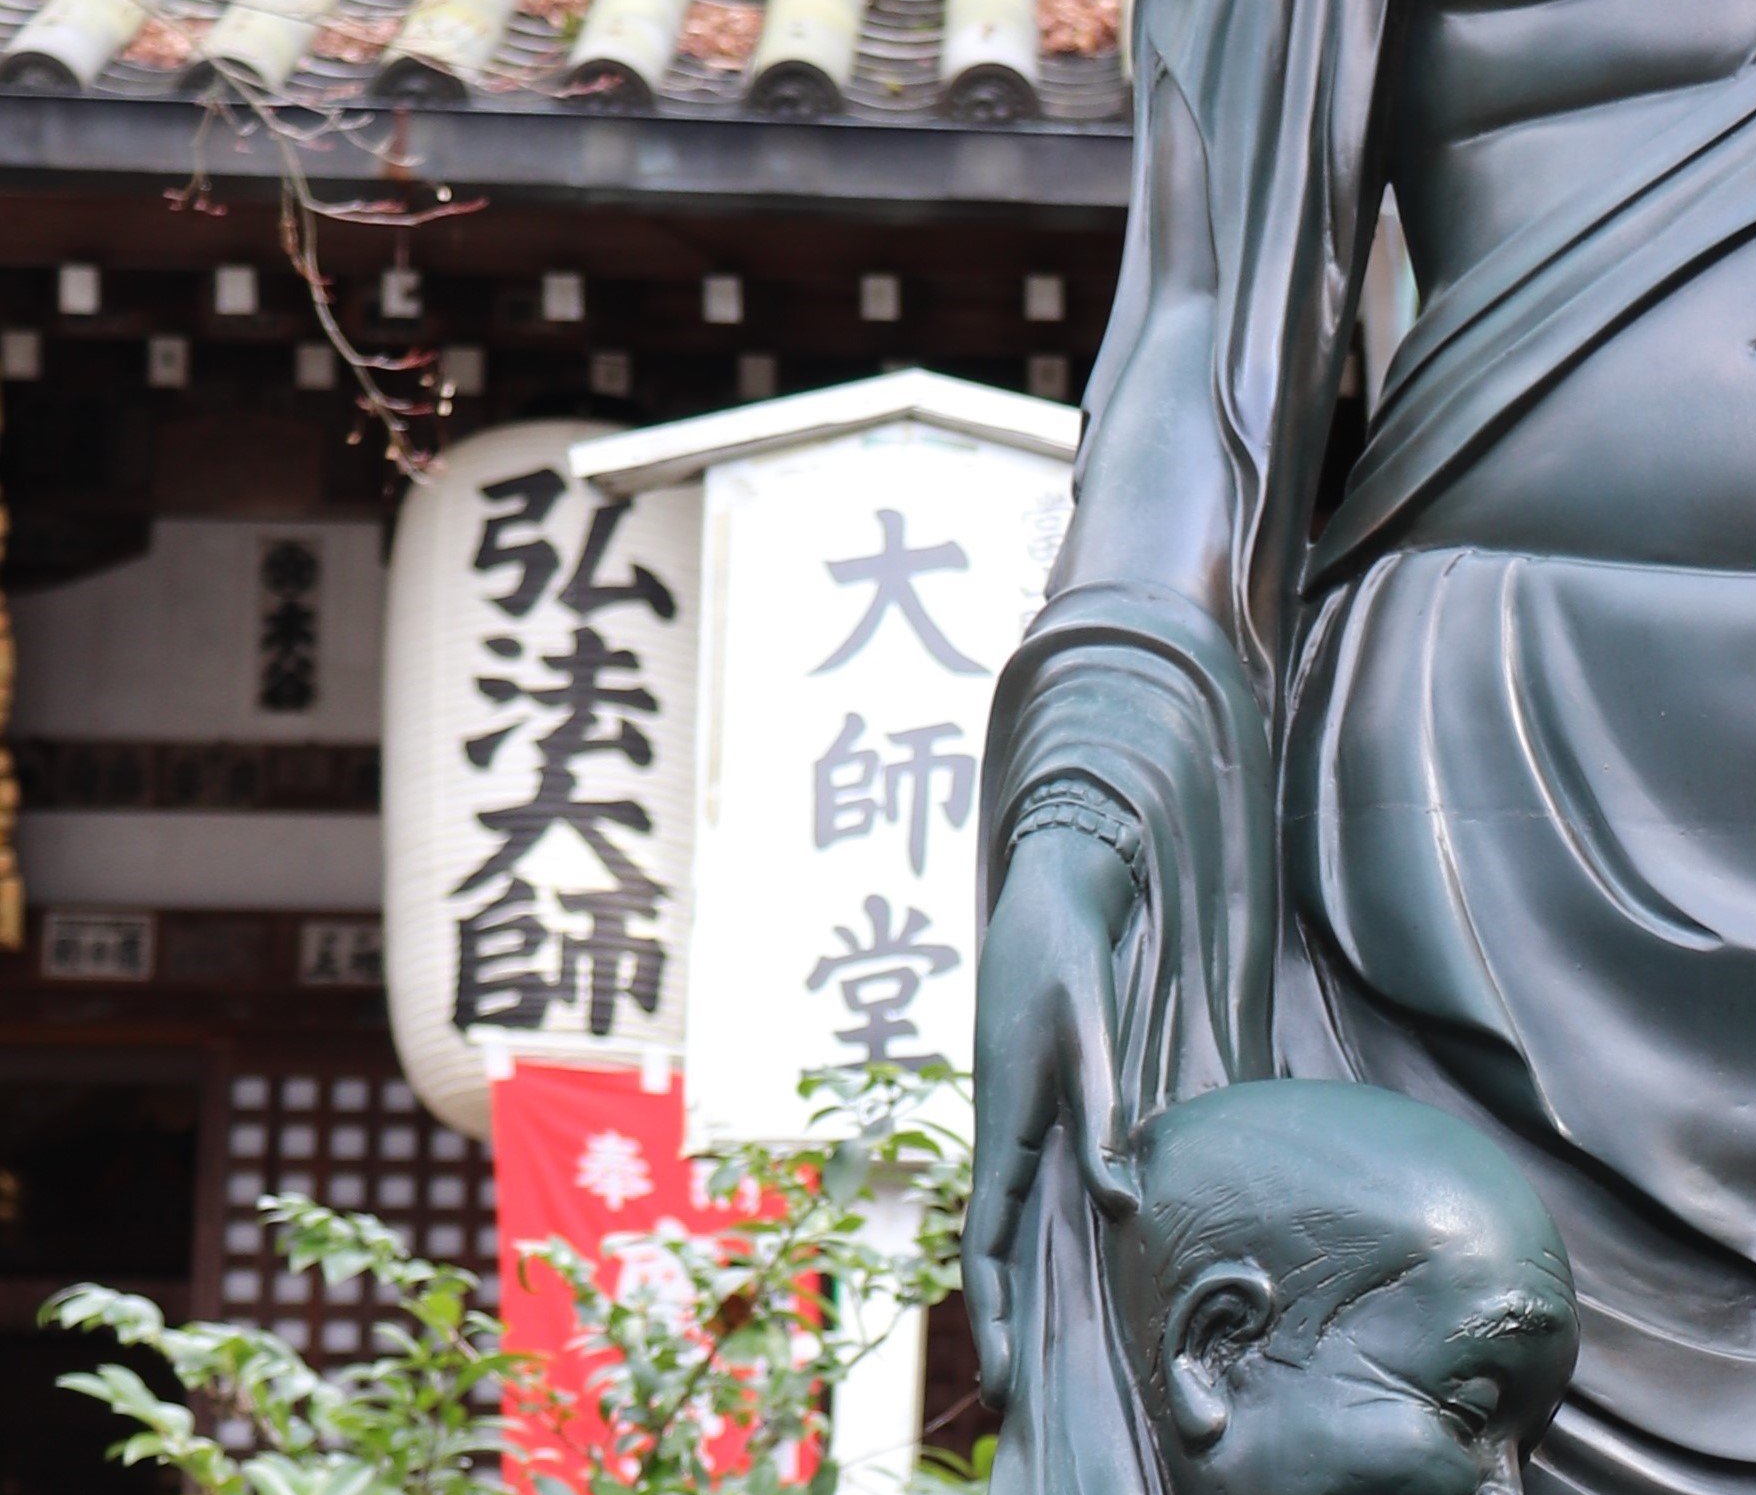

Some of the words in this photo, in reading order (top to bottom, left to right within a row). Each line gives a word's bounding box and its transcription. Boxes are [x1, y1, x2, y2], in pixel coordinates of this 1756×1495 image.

[448, 468, 678, 1036] 弘法大師
[800, 508, 994, 1078] 大師堂
